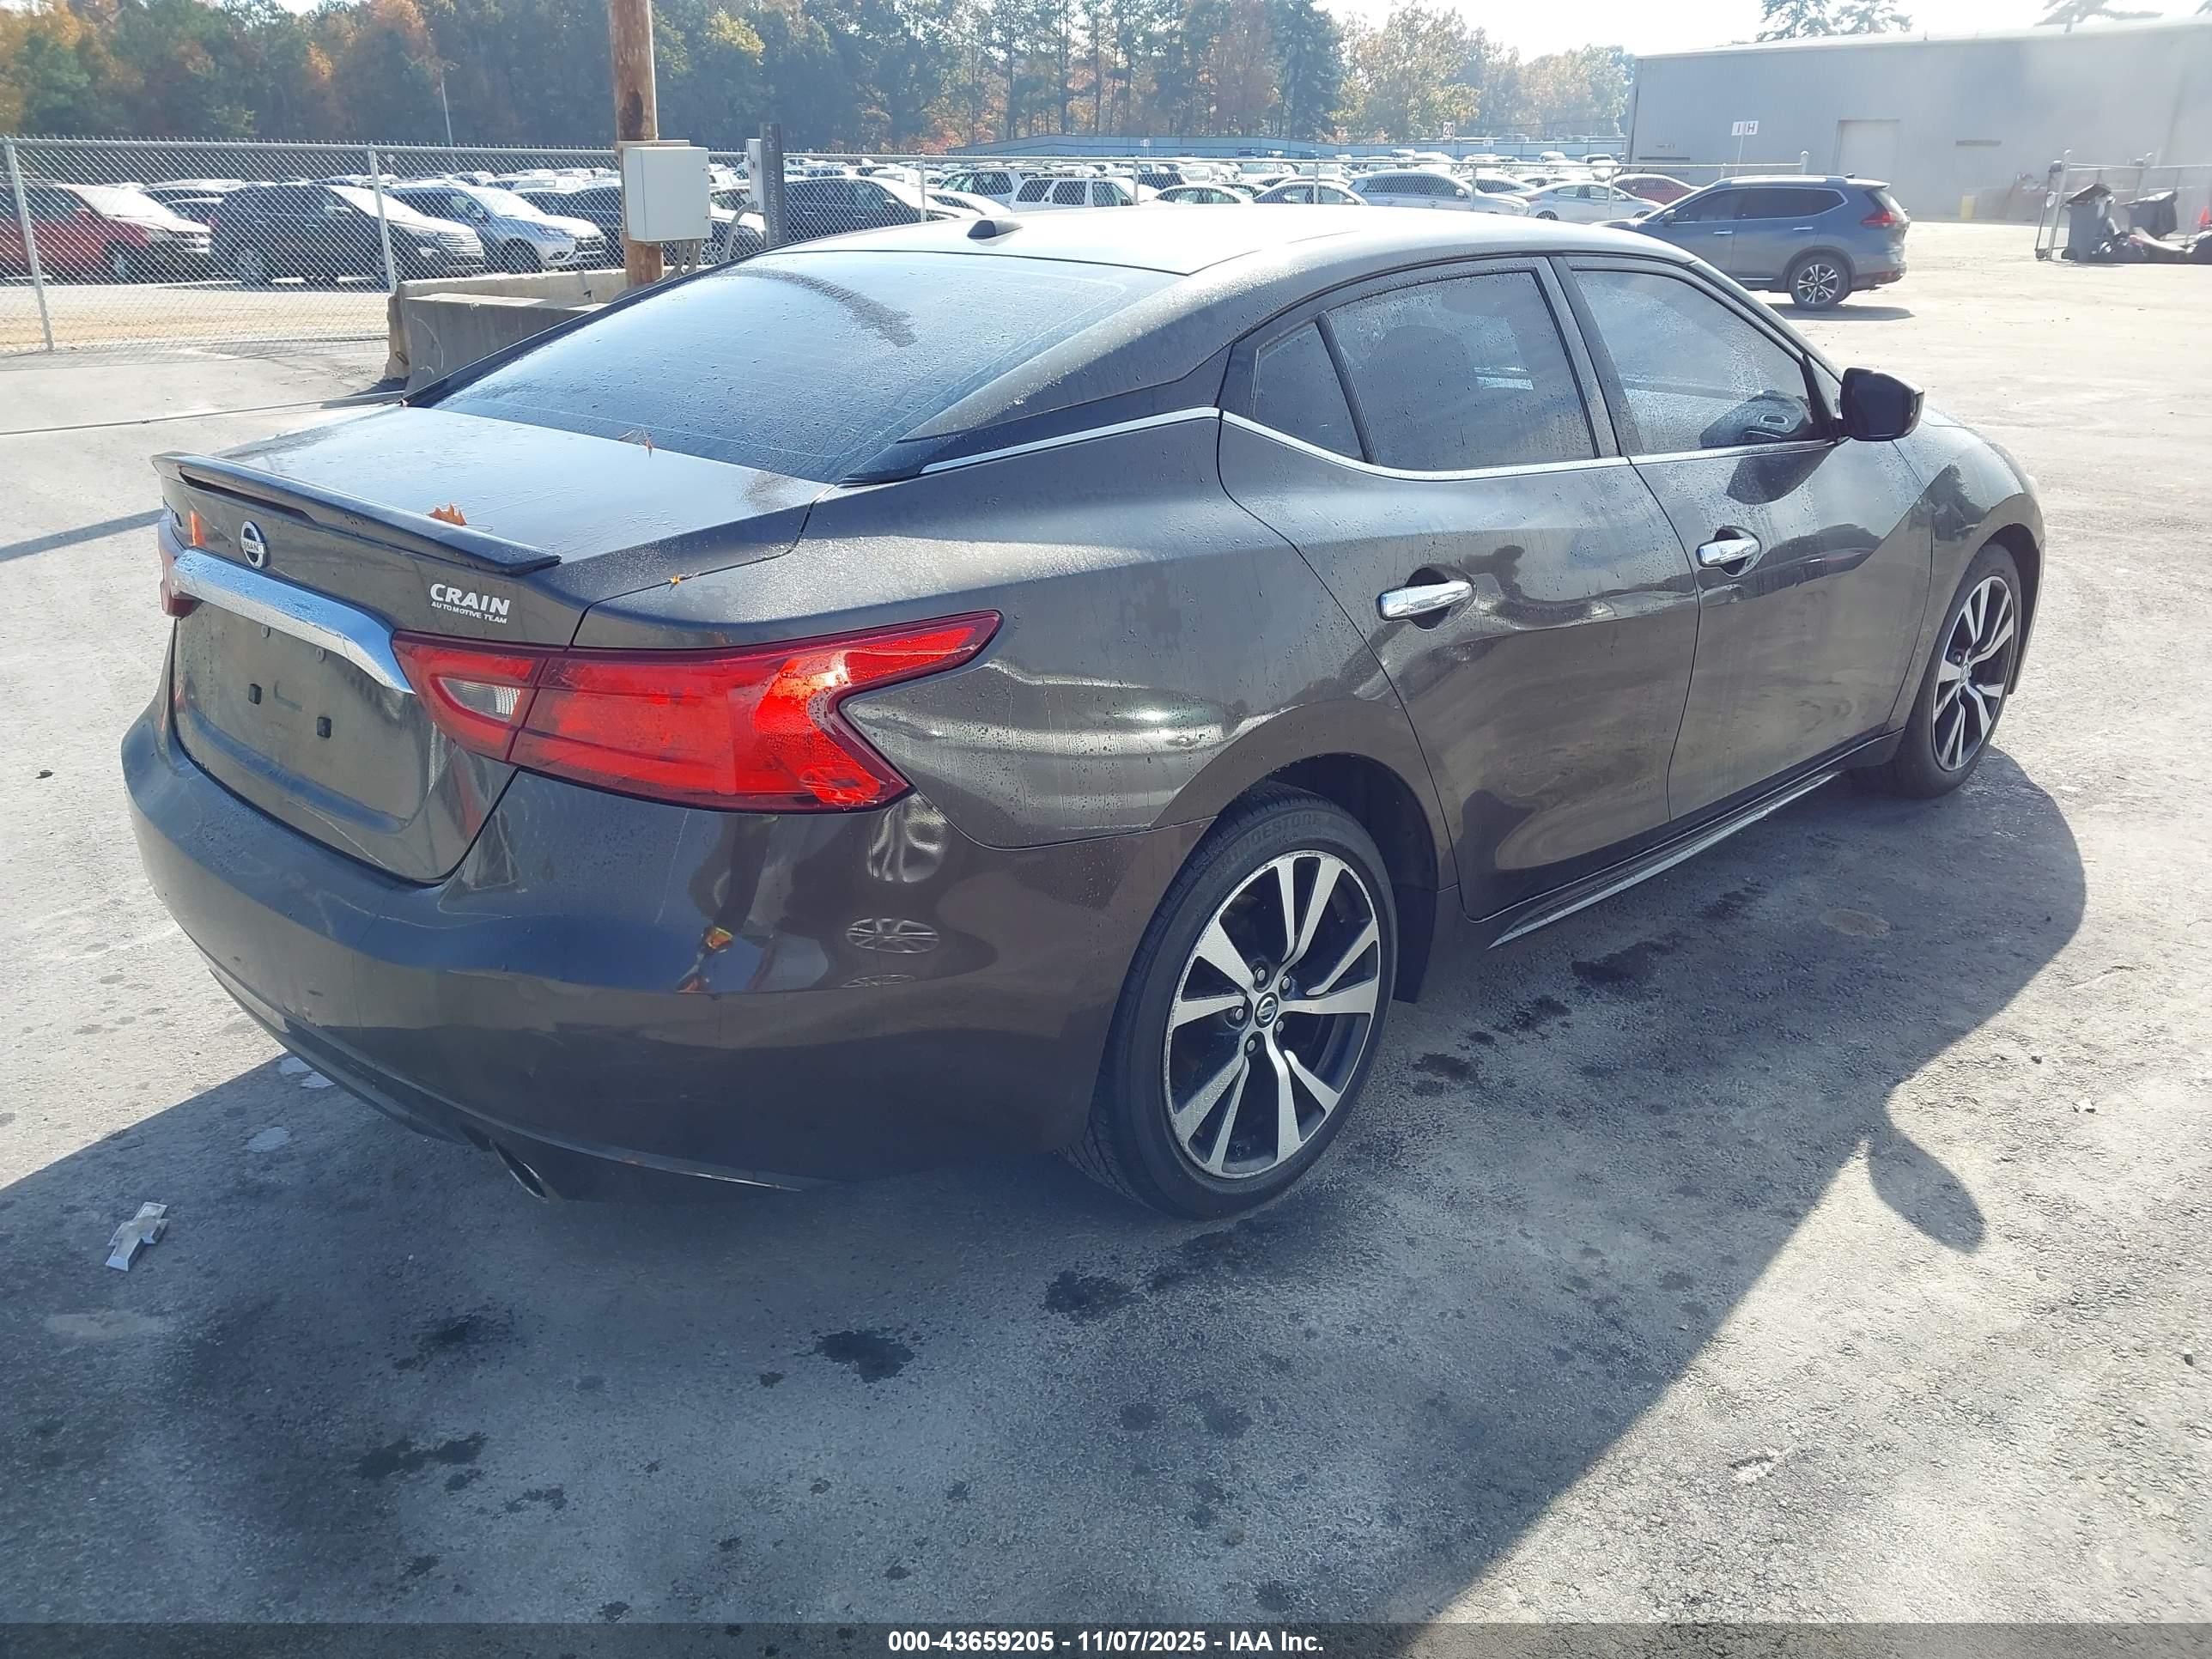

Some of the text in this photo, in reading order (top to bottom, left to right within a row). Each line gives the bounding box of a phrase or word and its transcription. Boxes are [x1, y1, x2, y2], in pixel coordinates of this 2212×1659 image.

[1443, 124, 1454, 136] 20
[1747, 124, 1756, 134] H
[430, 584, 510, 615] CRAIN
[431, 601, 508, 623] AUTOMOTIVE TEAM
